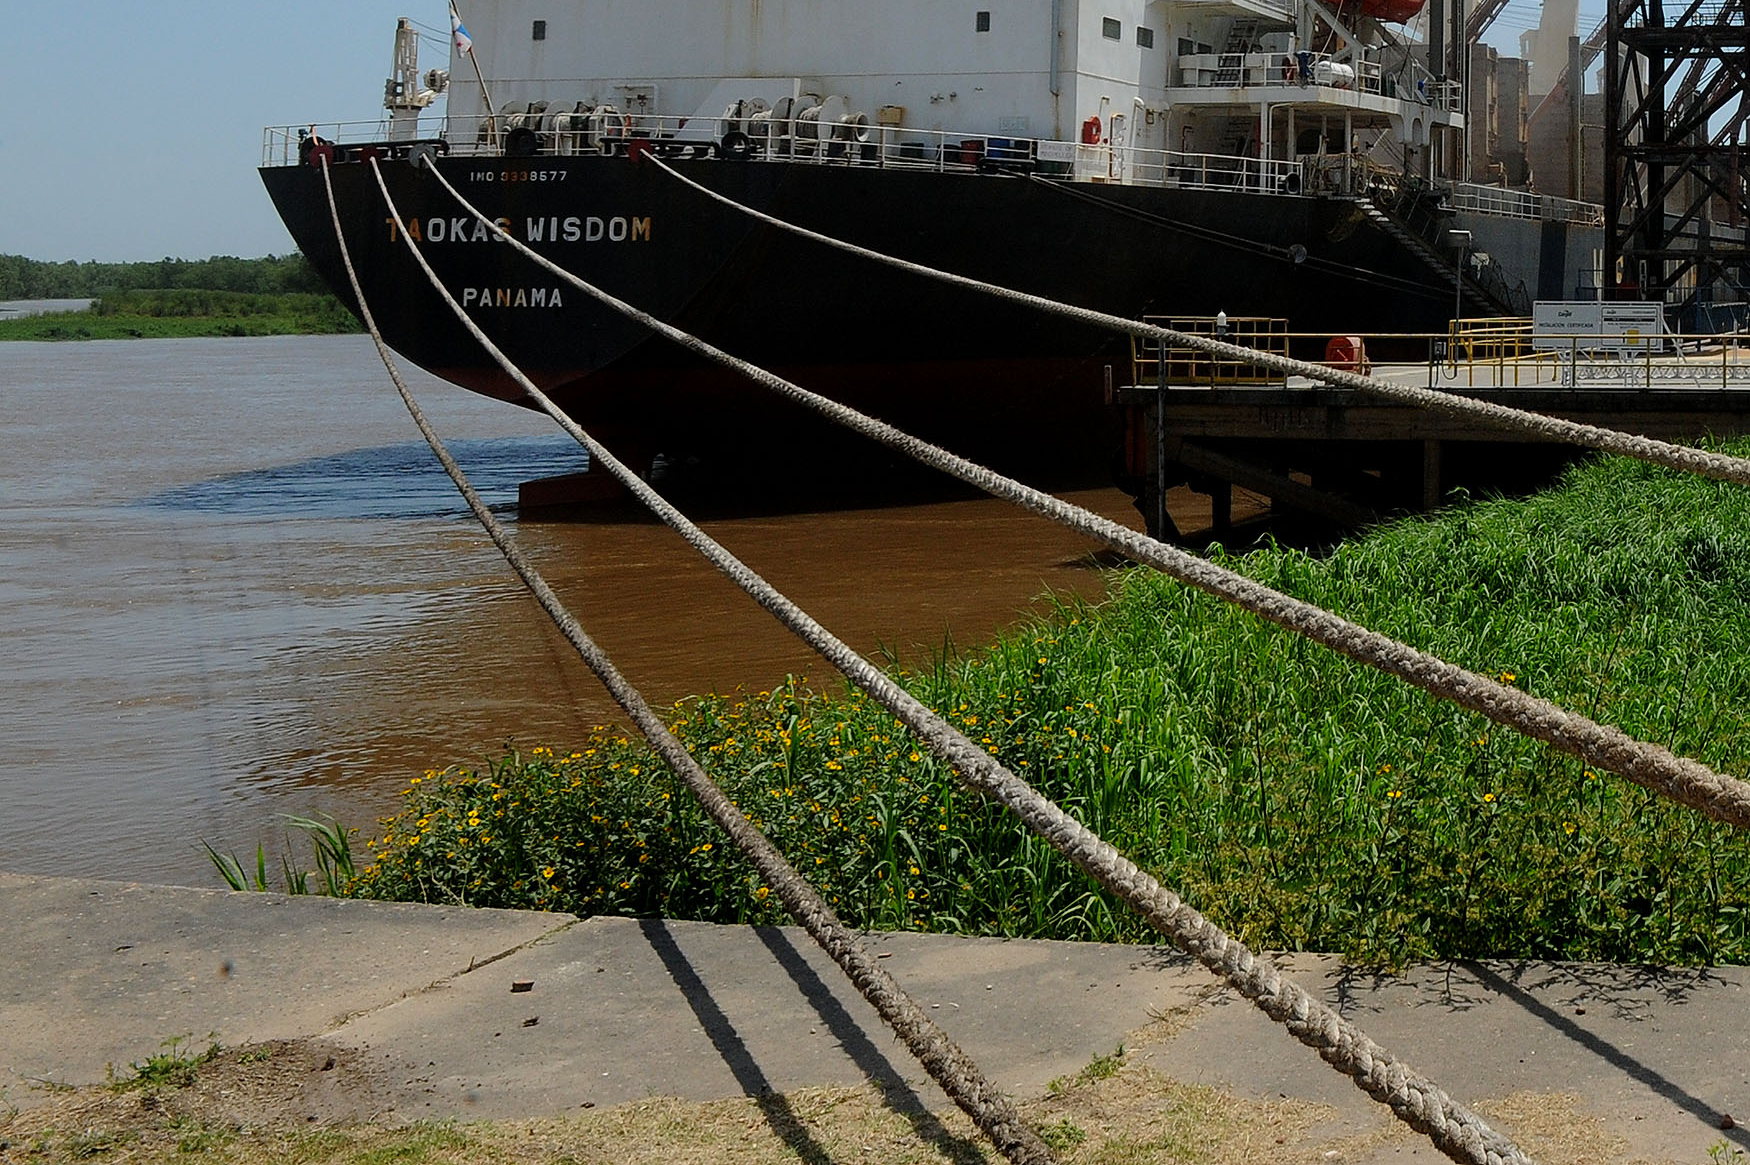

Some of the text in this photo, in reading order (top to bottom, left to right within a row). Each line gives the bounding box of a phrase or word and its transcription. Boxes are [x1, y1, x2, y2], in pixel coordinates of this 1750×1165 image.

[470, 170, 495, 182] IMO
[385, 216, 652, 243] TAOKAS WISDOM
[462, 287, 564, 309] PANAMA
